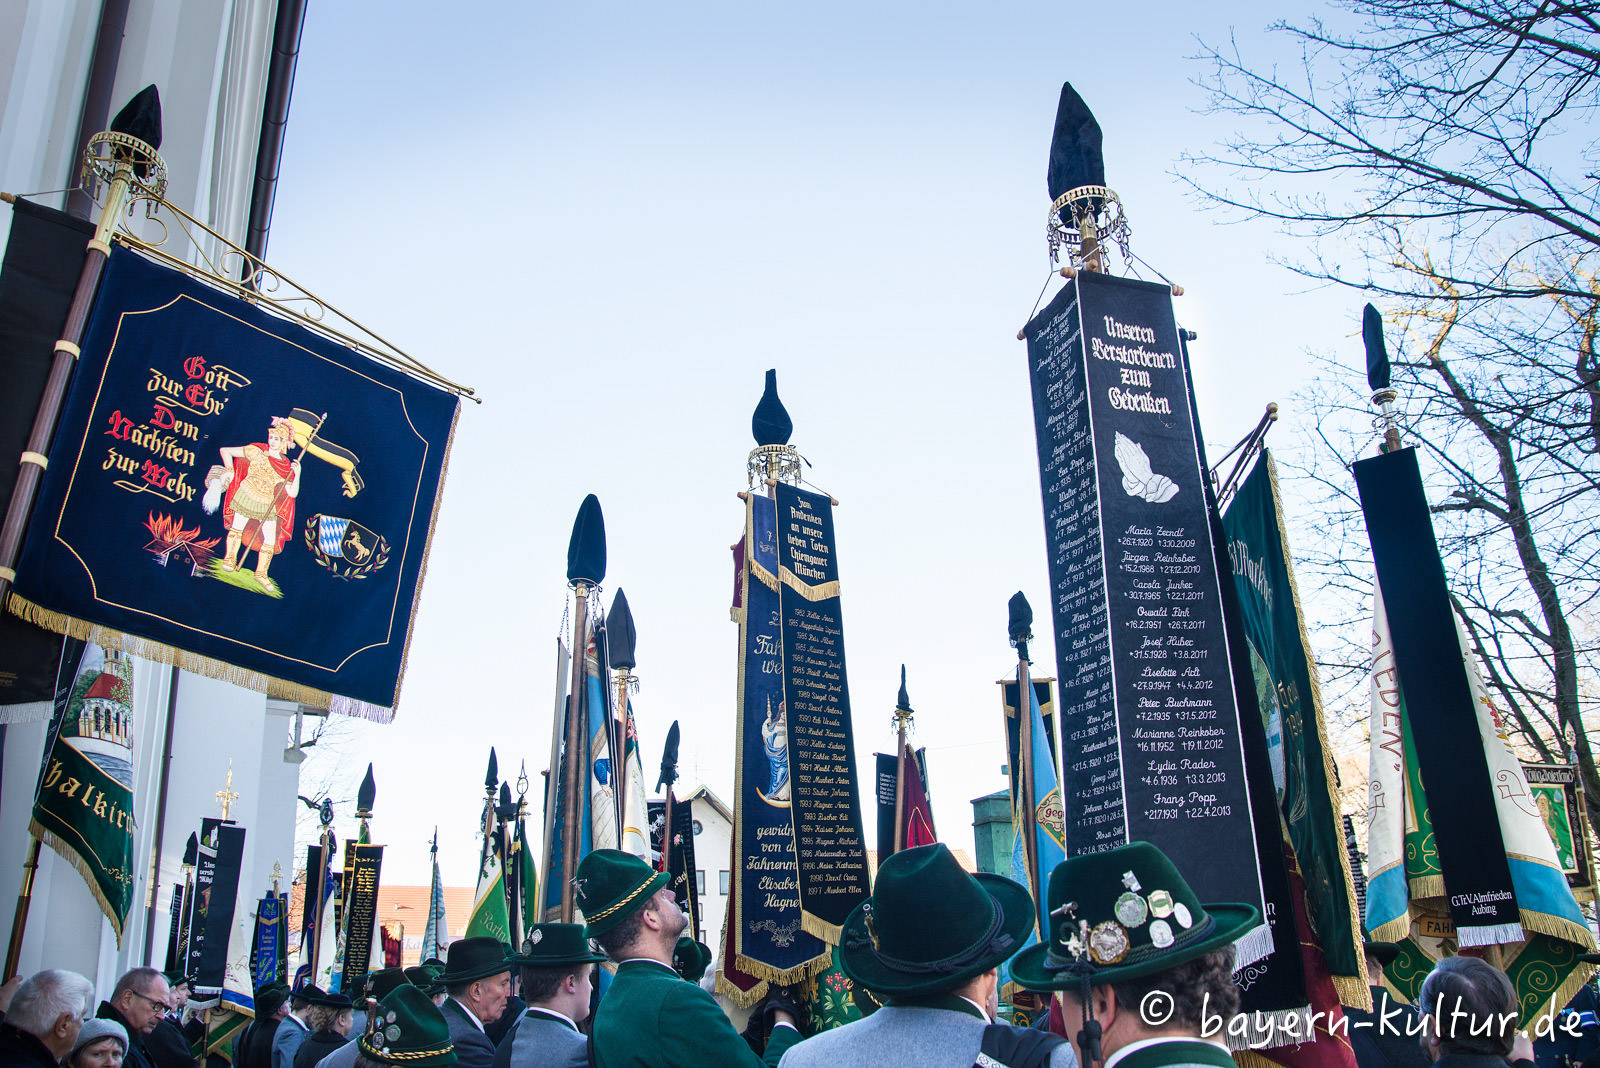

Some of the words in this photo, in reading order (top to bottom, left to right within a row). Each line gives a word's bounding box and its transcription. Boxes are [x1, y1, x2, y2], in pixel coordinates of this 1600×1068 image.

[1103, 315, 1156, 344] Unseren
[1092, 338, 1176, 369] Verstorbenen
[147, 368, 183, 397] zur
[184, 355, 251, 393] Gott
[1120, 368, 1152, 388] zum
[1108, 387, 1172, 415] Gedenken
[150, 404, 199, 441] Dem
[102, 447, 140, 475] zur
[141, 459, 196, 502] Wehr
[790, 506, 823, 525] Andenken
[791, 523, 799, 532] an
[802, 525, 823, 540] unsere
[1123, 525, 1152, 539] Maria
[1154, 526, 1184, 536] Zerndl
[788, 534, 807, 549] lieben
[810, 538, 829, 554] Toten
[790, 546, 828, 567] Chiemgauer
[1121, 551, 1149, 565] Jürgen
[1154, 552, 1196, 562] Reinkober
[794, 562, 826, 581] München
[1133, 579, 1161, 589] Carola
[1166, 579, 1194, 593] Junker
[1137, 606, 1167, 616] Oswald
[1172, 607, 1189, 617] Fink
[1140, 636, 1163, 649] Josef
[1166, 636, 1193, 646] Huber
[1141, 666, 1176, 677] Liselotte
[1138, 697, 1160, 707] Peter
[1165, 697, 1212, 707] Buchmann
[1132, 728, 1175, 738] Marianne
[1178, 726, 1225, 740] Reinkober
[1148, 760, 1177, 774] Lydia
[1181, 758, 1216, 769] Rader
[1154, 793, 1185, 808] Franz
[1189, 792, 1218, 808] Popp
[761, 843, 781, 852] von
[1472, 904, 1497, 915] Aubing
